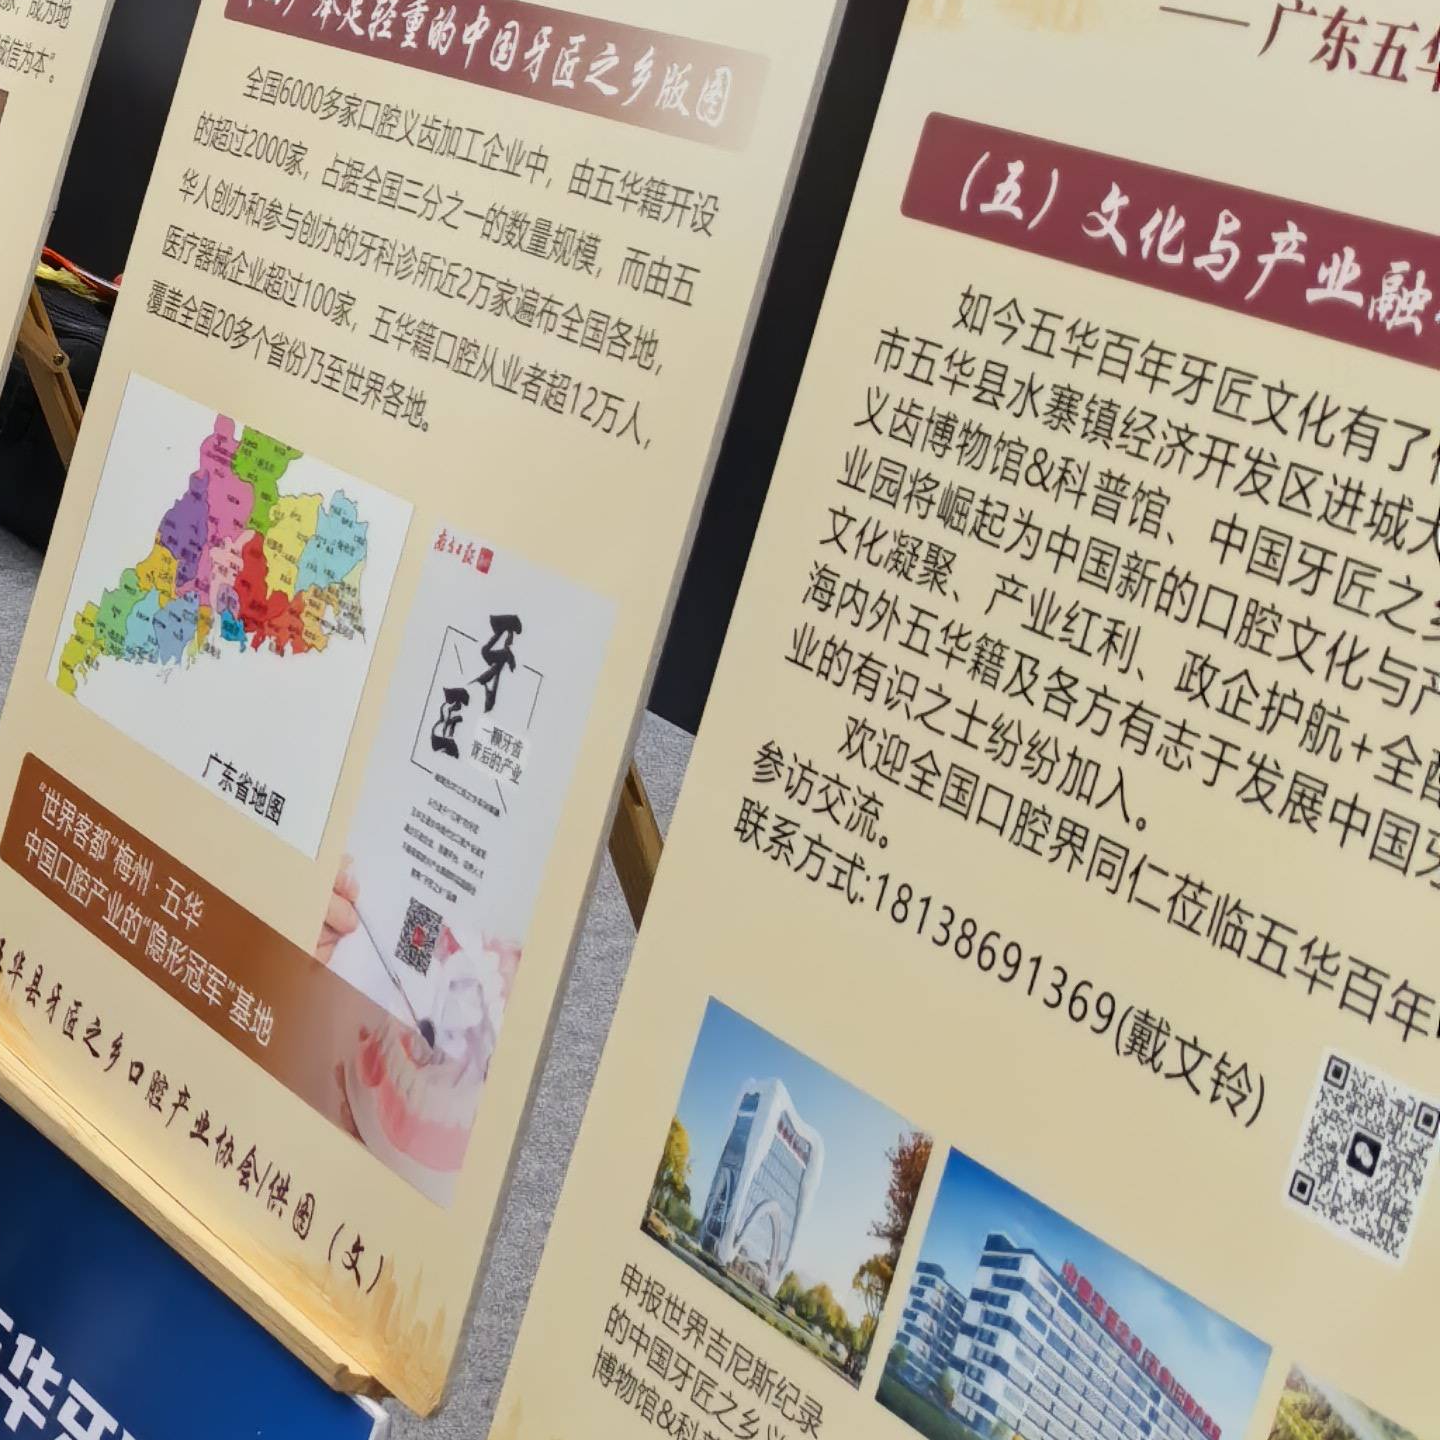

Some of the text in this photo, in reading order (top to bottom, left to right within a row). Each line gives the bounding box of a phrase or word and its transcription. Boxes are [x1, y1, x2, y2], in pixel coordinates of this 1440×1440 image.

[188, 113, 706, 311] 的超过2000家，占据全国三分之一的数量规模，而由五
[237, 63, 727, 241] 全国6000多家口腔义齿加工企业中，由五华籍开设
[959, 151, 1440, 334] （五）文化与产业融
[141, 279, 441, 437] 覆盖全国20多个省份乃至世界各地。
[953, 284, 1440, 479] 如今五华百年牙匠文化有了
[200, 748, 287, 829] 广东省地图
[752, 738, 891, 852] 参访交流。
[785, 623, 1150, 832] 业的有识之士纷纷加入。
[838, 715, 1440, 1045] 欢迎全国口腔界同仁莅临五华百年
